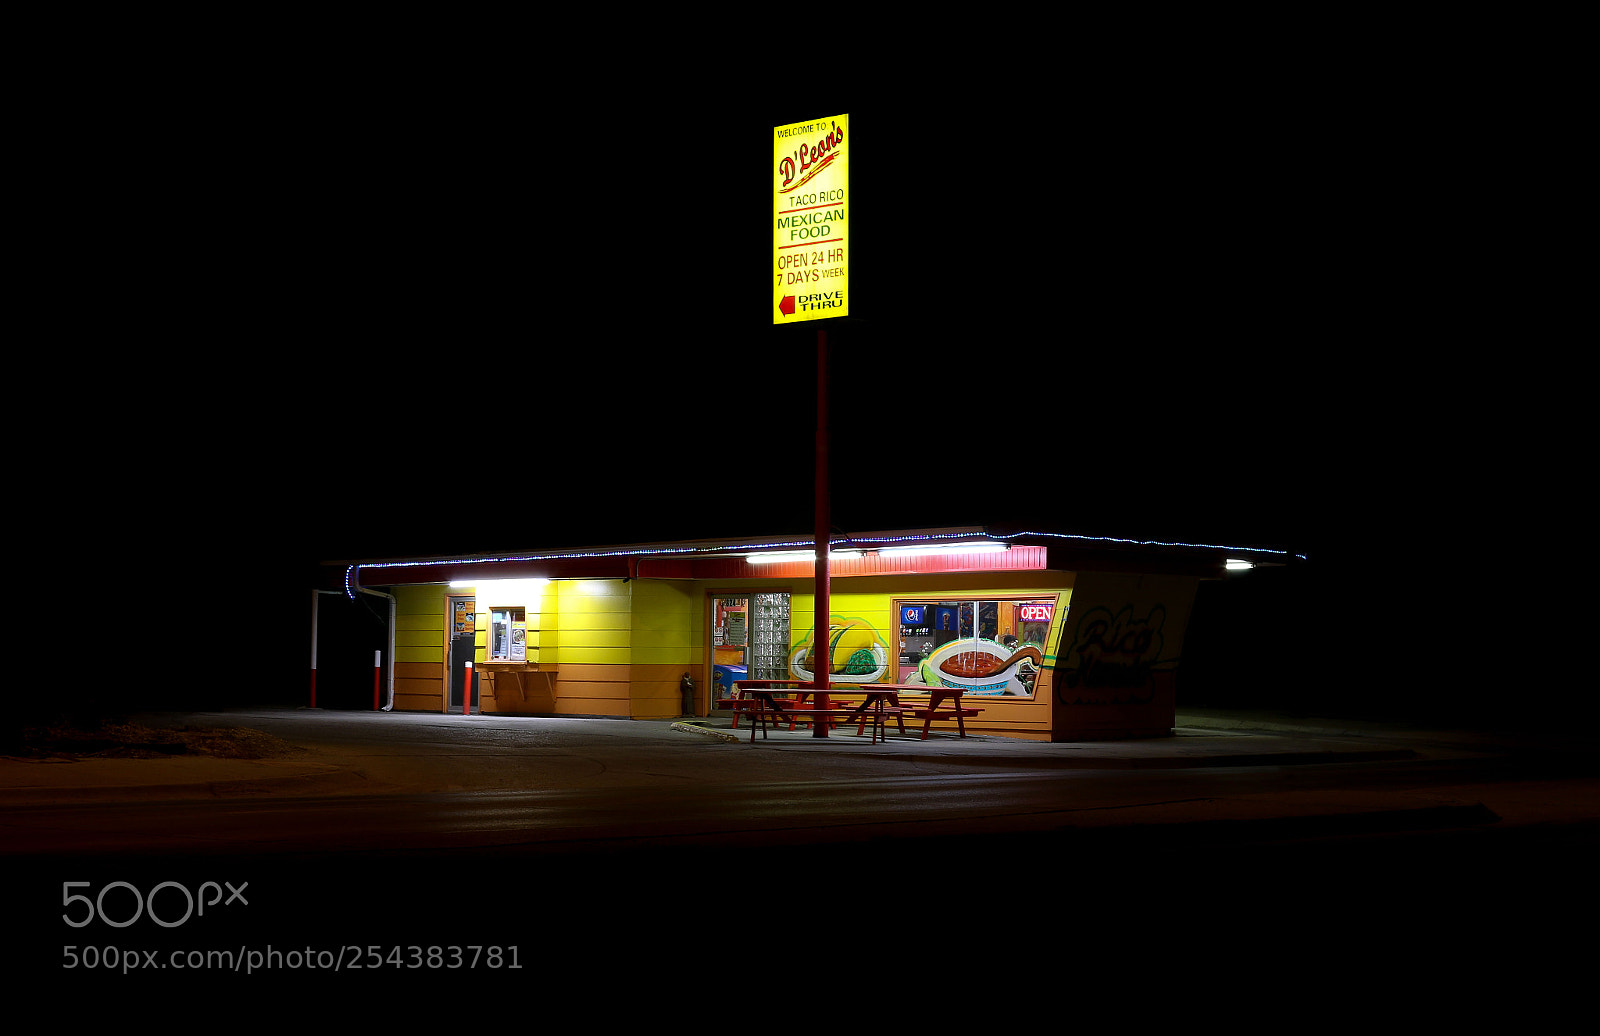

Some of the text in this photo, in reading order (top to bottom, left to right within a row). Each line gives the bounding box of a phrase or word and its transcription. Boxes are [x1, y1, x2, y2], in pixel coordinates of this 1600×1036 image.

[777, 122, 827, 139] WELCOME TO
[779, 120, 844, 187] D'Leon's
[789, 188, 844, 207] TACO RICO
[777, 208, 844, 230] MEXICAN
[790, 224, 831, 241] FOOD
[778, 247, 844, 270] OPEN 24 HR
[777, 267, 845, 286] 7 DAYS WEEK
[798, 290, 844, 304] DRIVE
[799, 299, 843, 312] THRU
[1020, 606, 1052, 620] OPEN
